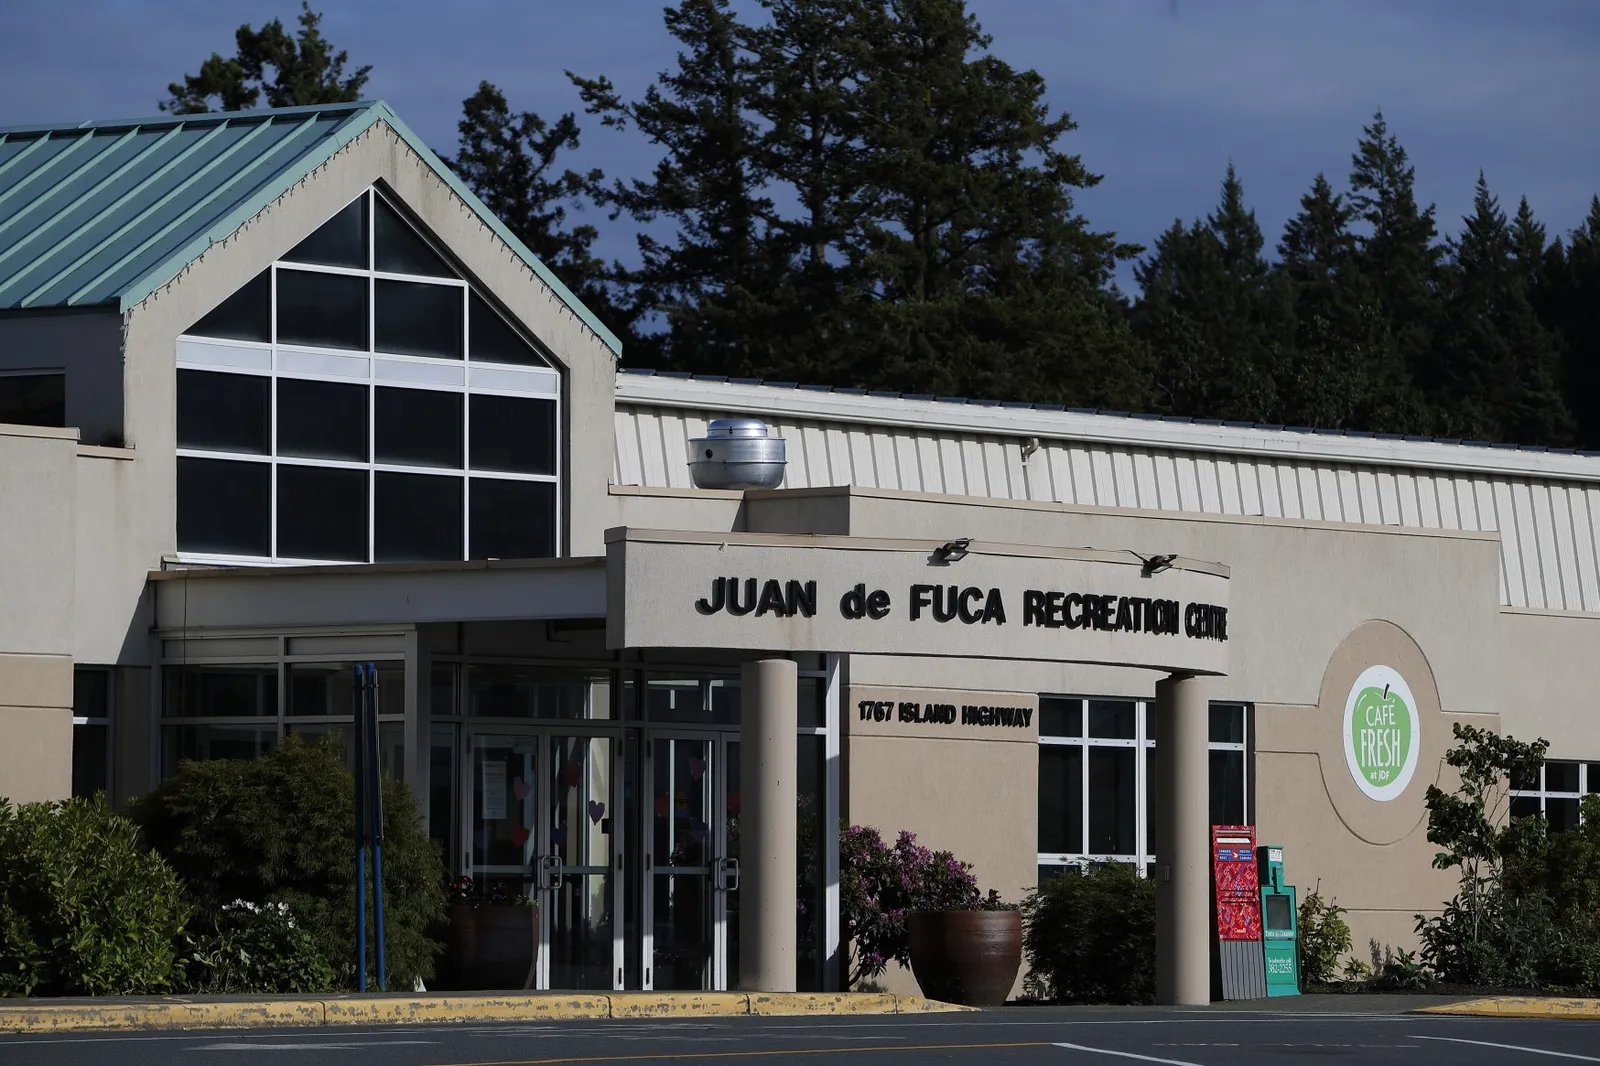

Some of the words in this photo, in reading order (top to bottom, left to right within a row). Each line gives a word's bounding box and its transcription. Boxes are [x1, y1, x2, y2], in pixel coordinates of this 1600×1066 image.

[695, 577, 816, 618] JUAN
[840, 583, 891, 620] de
[910, 584, 1006, 625] FUCA
[1023, 590, 1179, 636] RECREATION
[858, 701, 894, 722] 1767
[899, 702, 957, 724] ISLAND
[962, 705, 1033, 728] HIGHWAY
[1366, 699, 1396, 727] CAFÉ
[1360, 728, 1401, 768] FRESH
[1370, 771, 1378, 780] at
